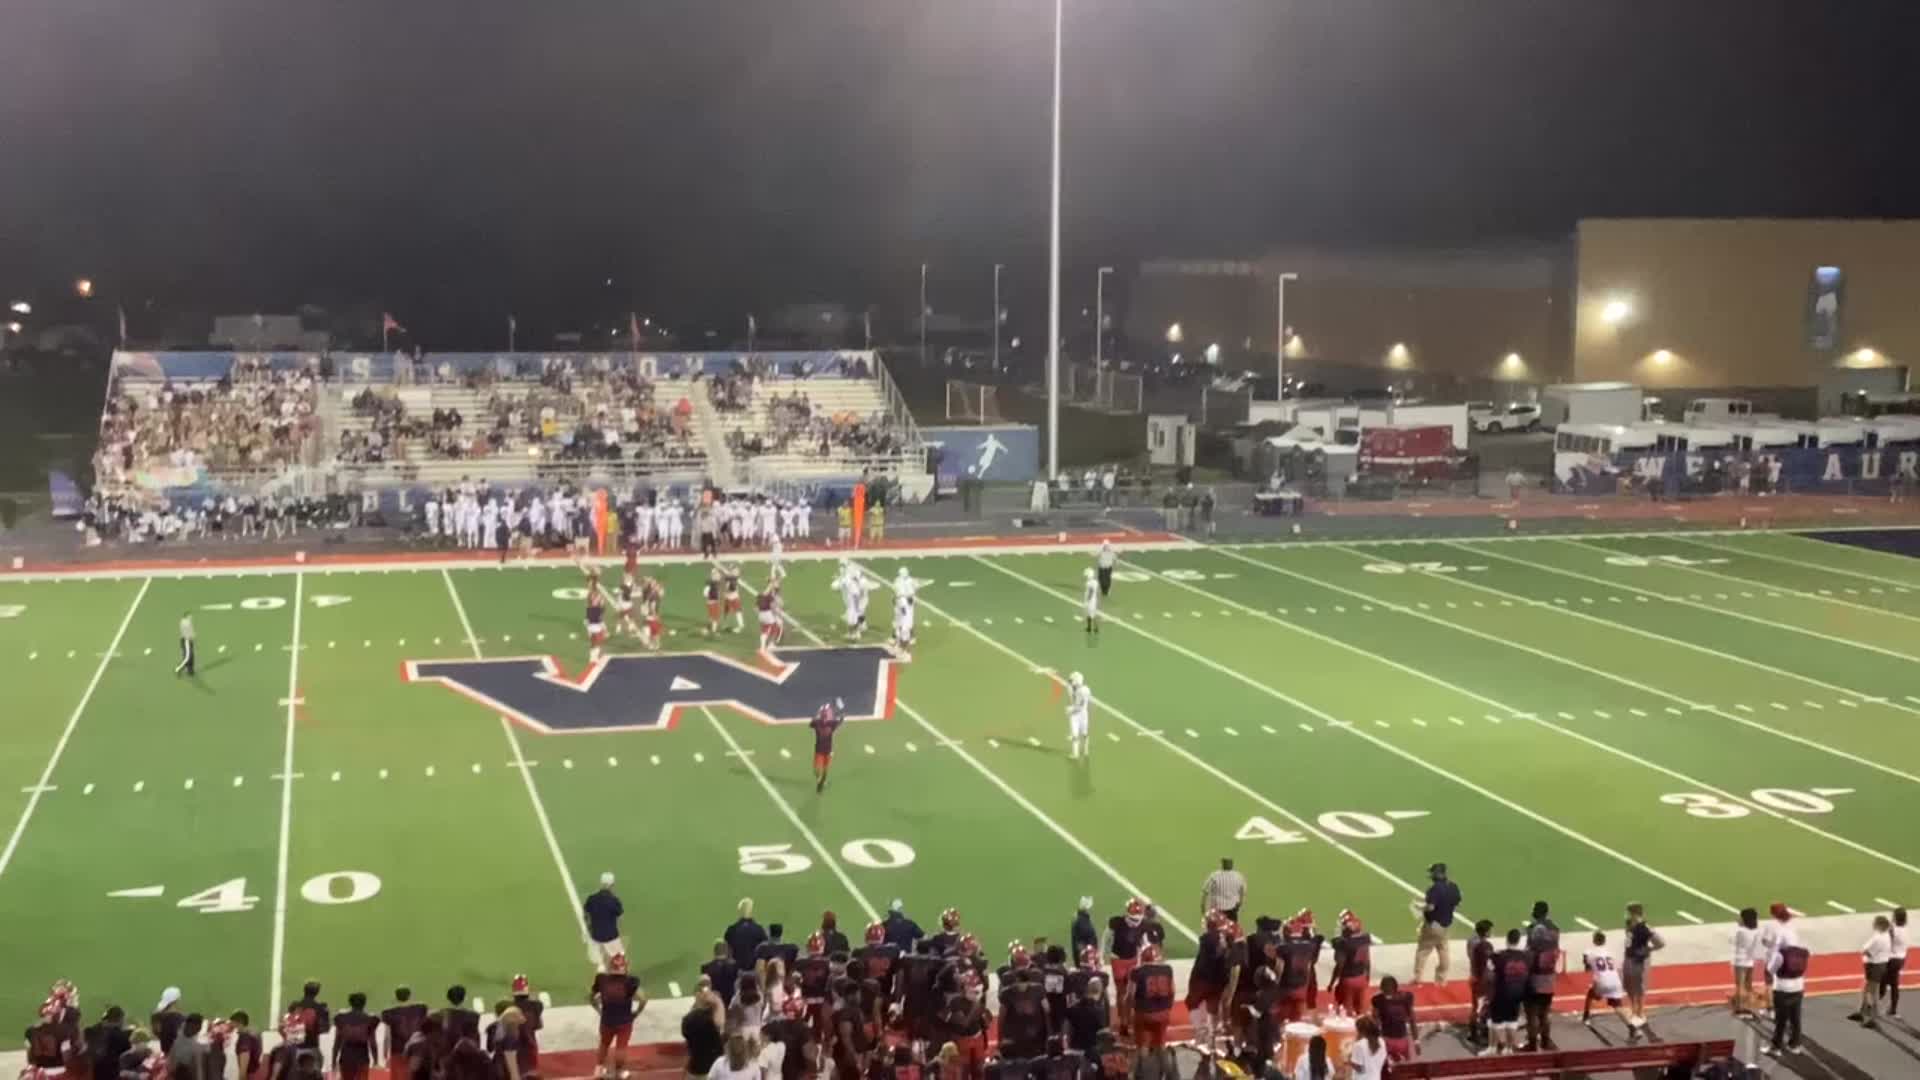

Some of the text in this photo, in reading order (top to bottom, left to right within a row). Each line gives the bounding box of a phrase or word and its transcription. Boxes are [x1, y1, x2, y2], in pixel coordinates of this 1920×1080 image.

[1659, 786, 1835, 821] 30
[1234, 809, 1396, 845] 40
[736, 838, 916, 876] 50
[176, 870, 382, 914] 40
